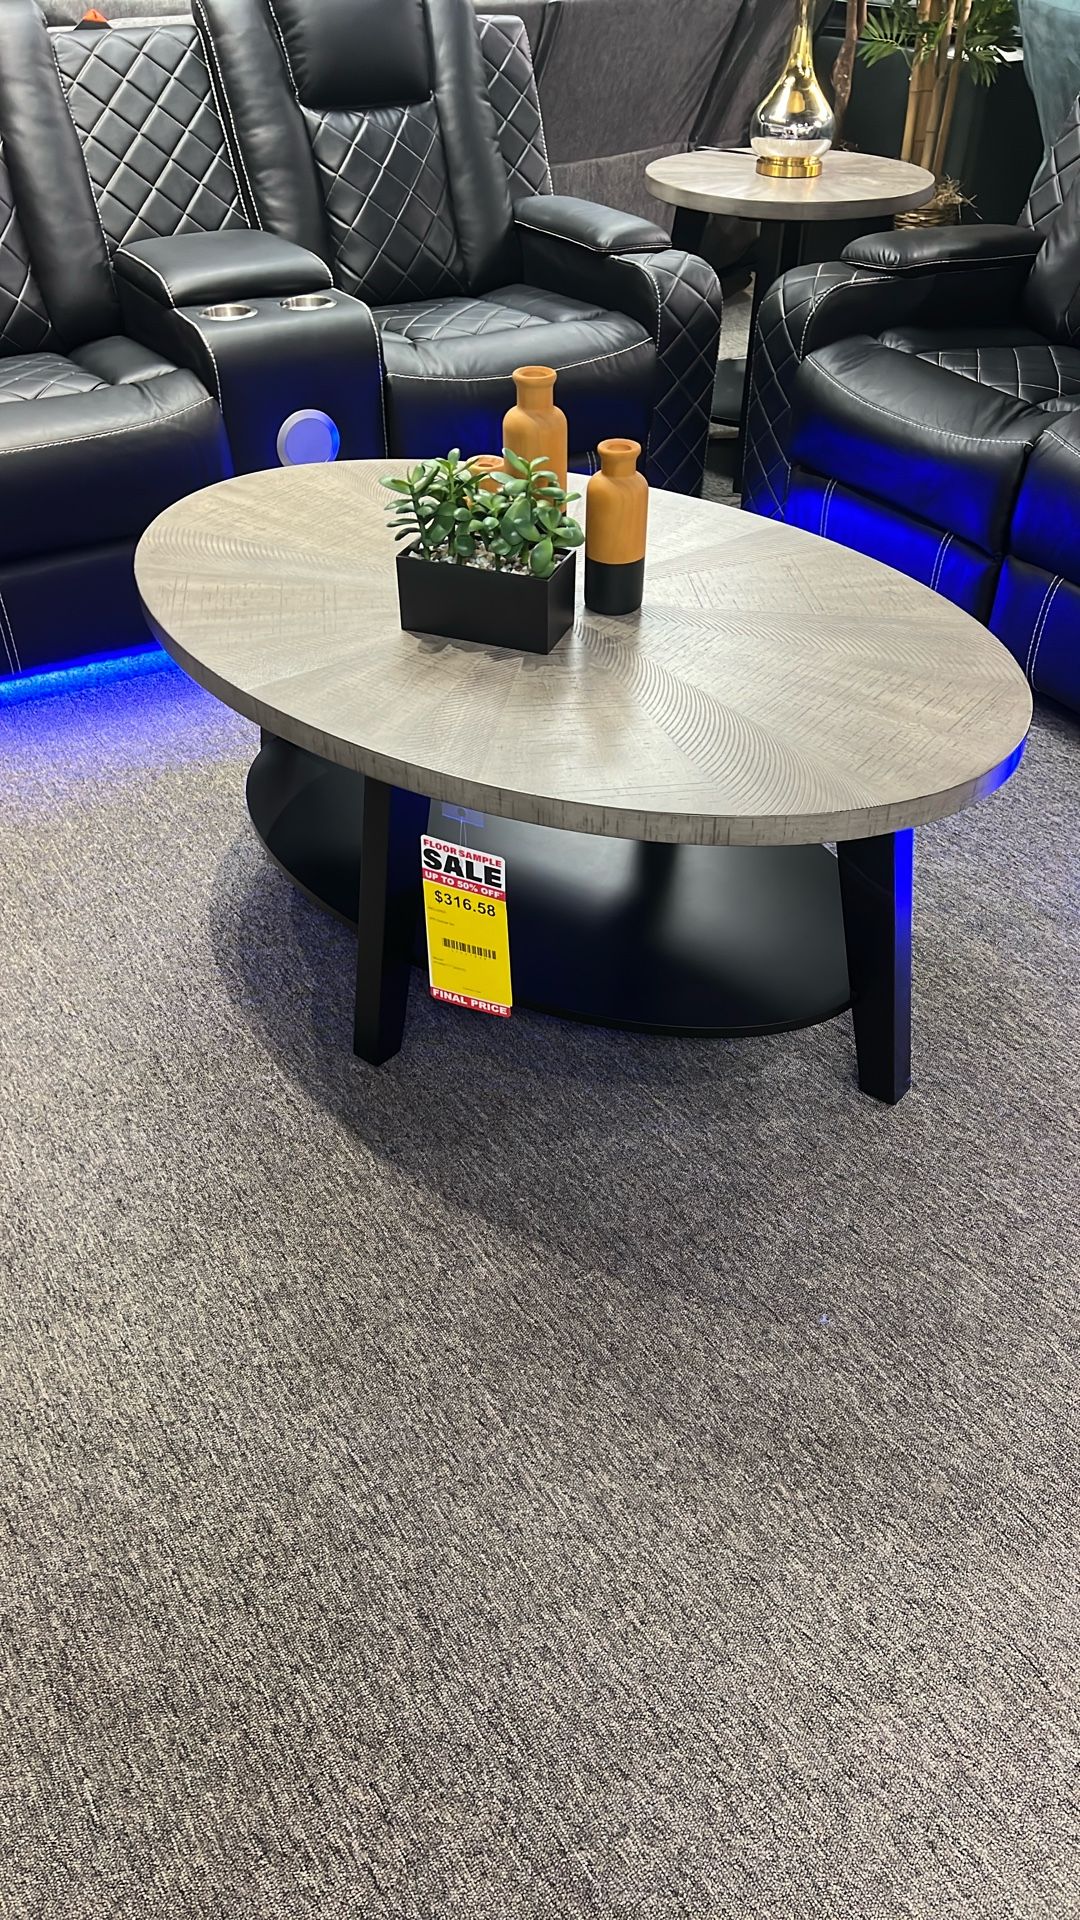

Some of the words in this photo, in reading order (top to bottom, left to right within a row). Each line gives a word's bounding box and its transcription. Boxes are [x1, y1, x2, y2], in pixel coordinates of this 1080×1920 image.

[423, 838, 457, 855] FLOOR
[458, 849, 502, 868] SAMPLE
[423, 848, 503, 889] SALE
[424, 870, 439, 881] UP
[440, 874, 455, 886] TO
[457, 879, 479, 893] 50%
[434, 889, 496, 917] $316.58
[432, 988, 468, 1005] FINAL
[470, 999, 508, 1015] PRICE
